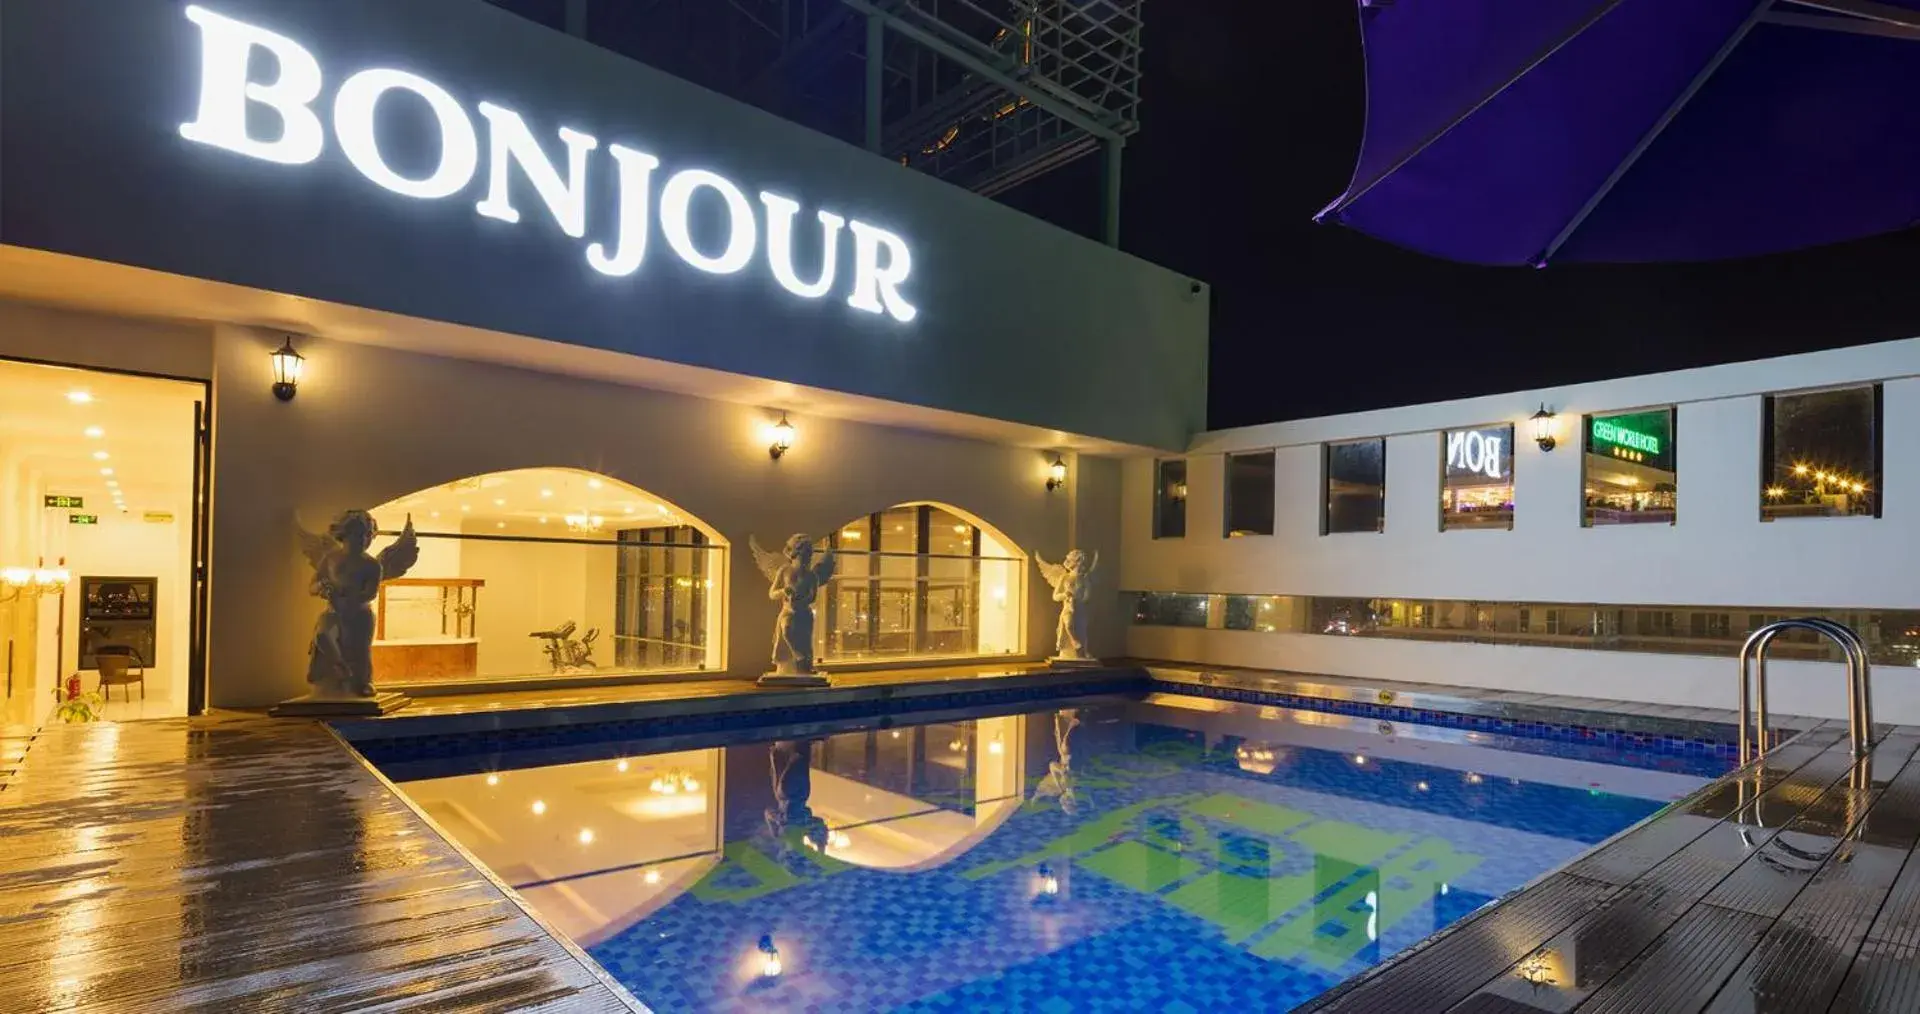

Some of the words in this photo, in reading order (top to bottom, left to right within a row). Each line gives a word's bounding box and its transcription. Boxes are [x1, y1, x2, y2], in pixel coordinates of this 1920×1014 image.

[180, 5, 917, 322] BONJOUR
[1593, 420, 1617, 442] GREEN
[1617, 426, 1640, 450] WORLD
[1640, 433, 1660, 455] HOTEL
